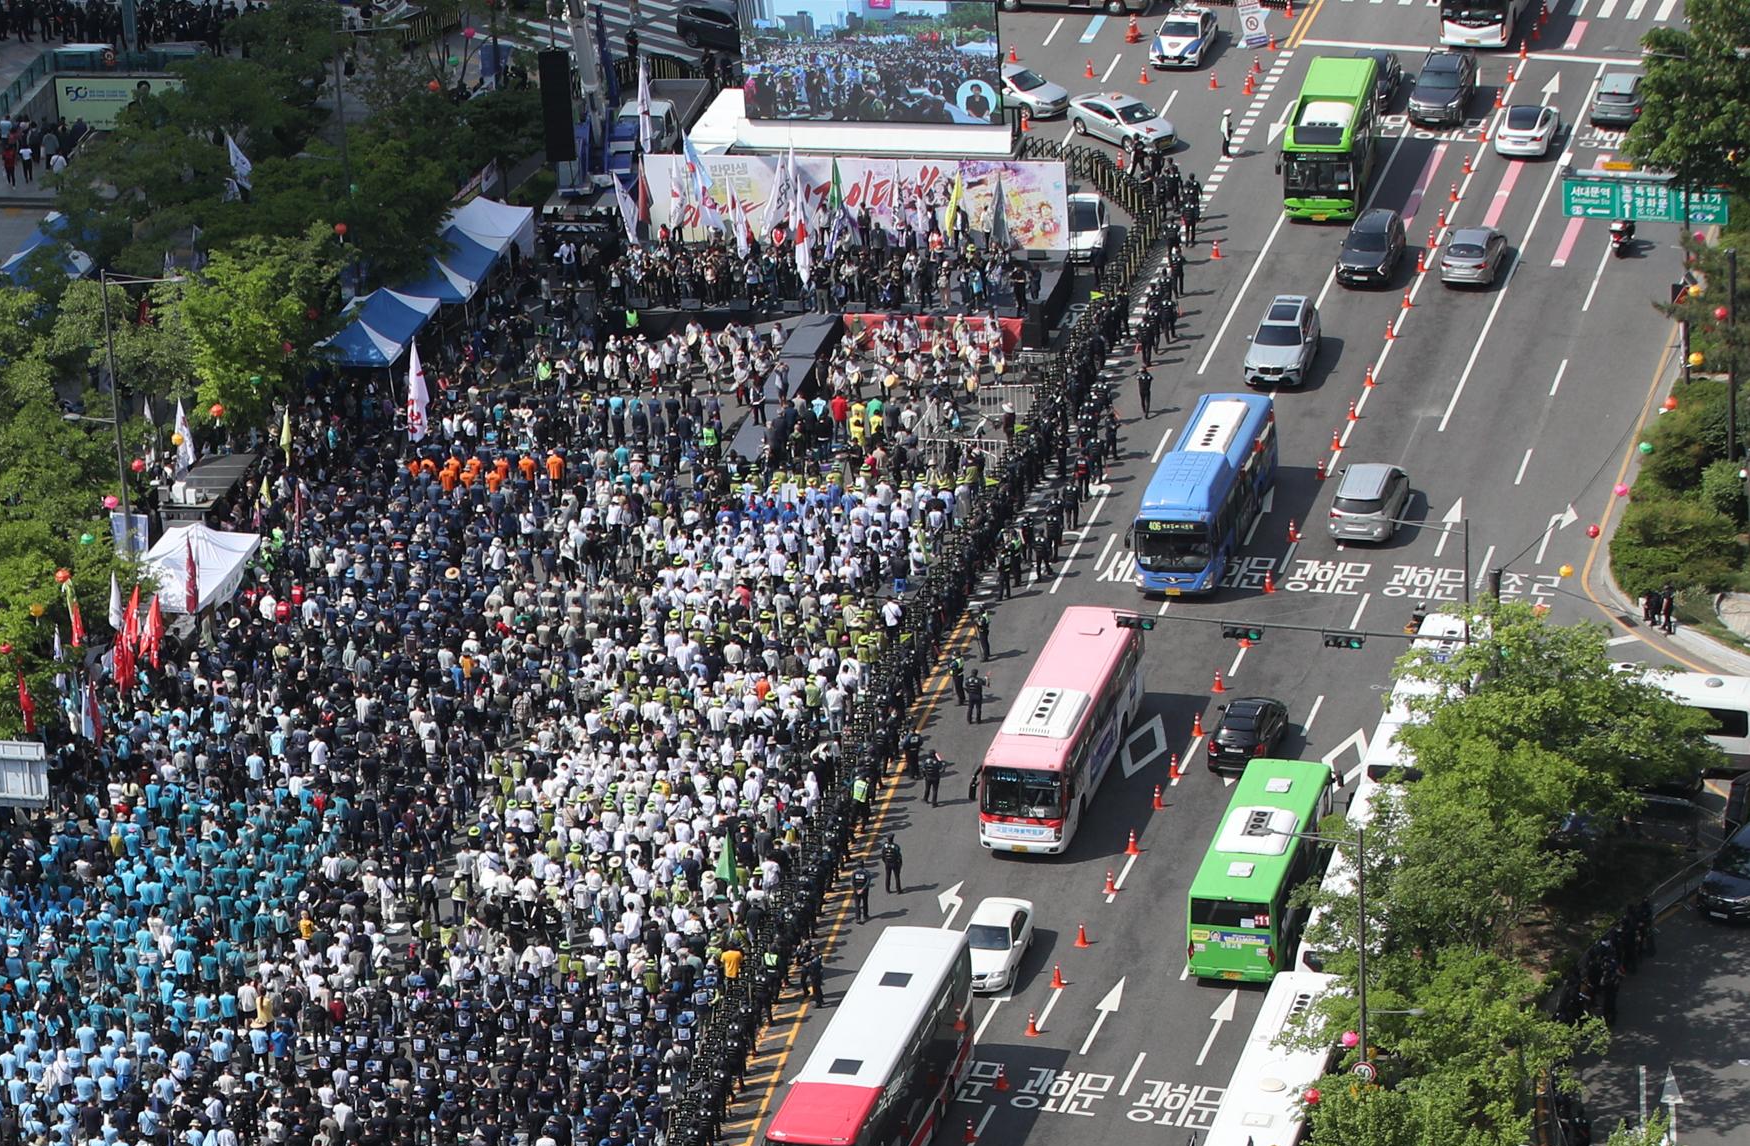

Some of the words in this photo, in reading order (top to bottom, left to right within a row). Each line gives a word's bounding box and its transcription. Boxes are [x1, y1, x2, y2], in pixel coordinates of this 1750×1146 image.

[1570, 186, 1611, 199] 서대문역
[1635, 197, 1668, 209] 광화문
[1149, 521, 1162, 531] 406
[1284, 559, 1372, 595] 광화문
[1382, 564, 1466, 600] 광화문
[1010, 1066, 1115, 1117] 광화문
[1126, 1079, 1228, 1131] 광화문
